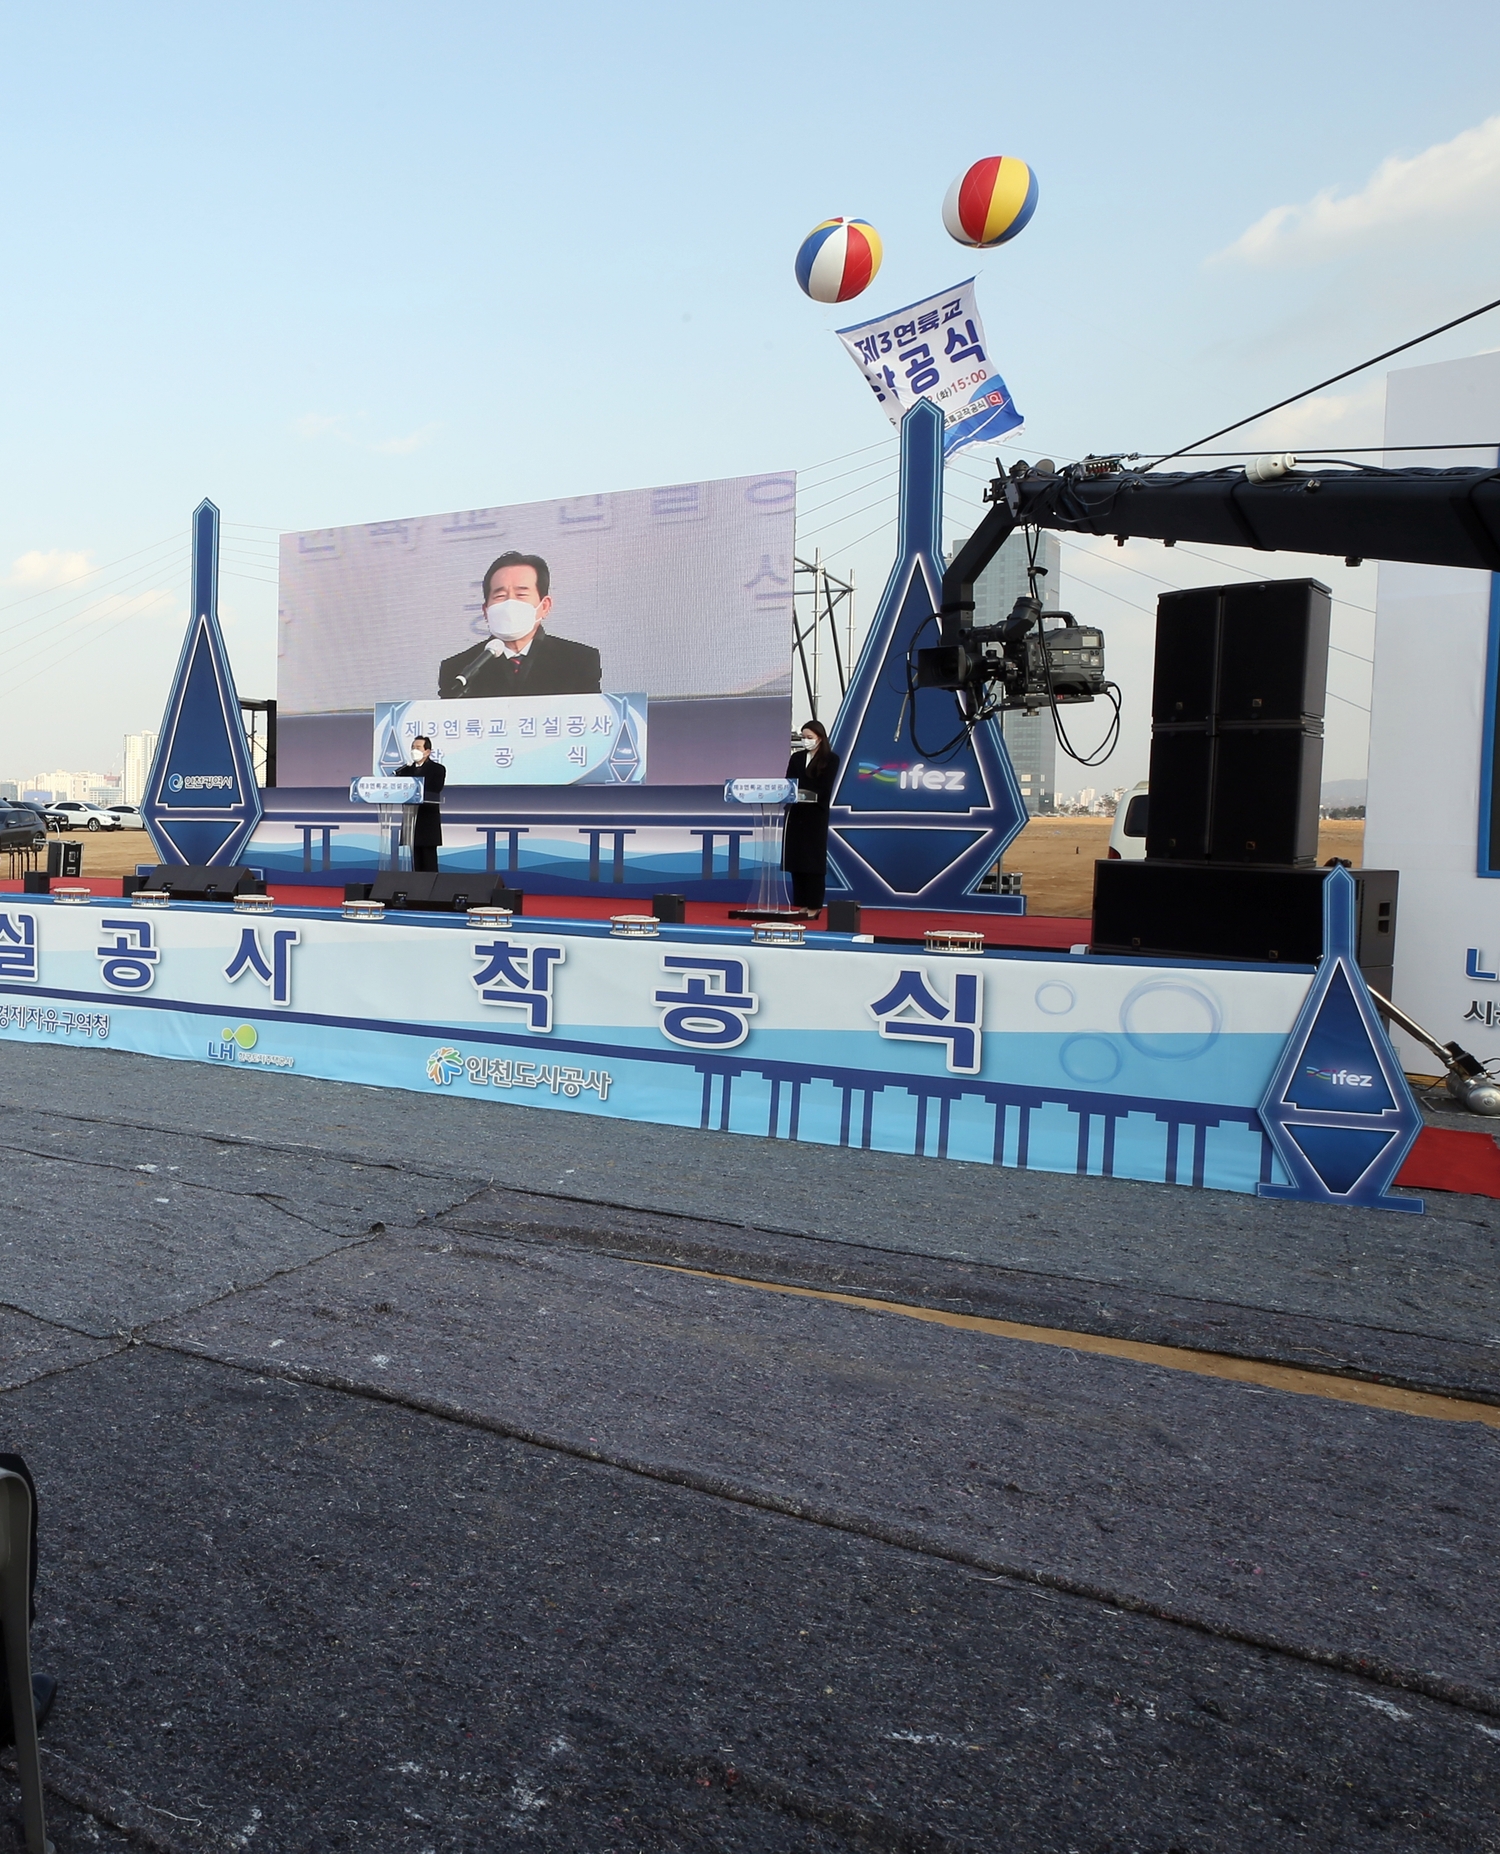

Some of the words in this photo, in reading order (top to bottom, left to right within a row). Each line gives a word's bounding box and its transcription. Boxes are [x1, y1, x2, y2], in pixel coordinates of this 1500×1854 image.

[854, 298, 963, 366] 제3연륙교
[405, 718, 509, 738] 제3연륙교
[518, 714, 613, 736] 건설공사
[184, 775, 233, 789] 인천광역시
[900, 763, 965, 790] ifez
[1466, 948, 1500, 980] L
[208, 1041, 234, 1060] LH
[466, 1056, 612, 1100] 인천도시공사
[1332, 1069, 1373, 1087] ifez
